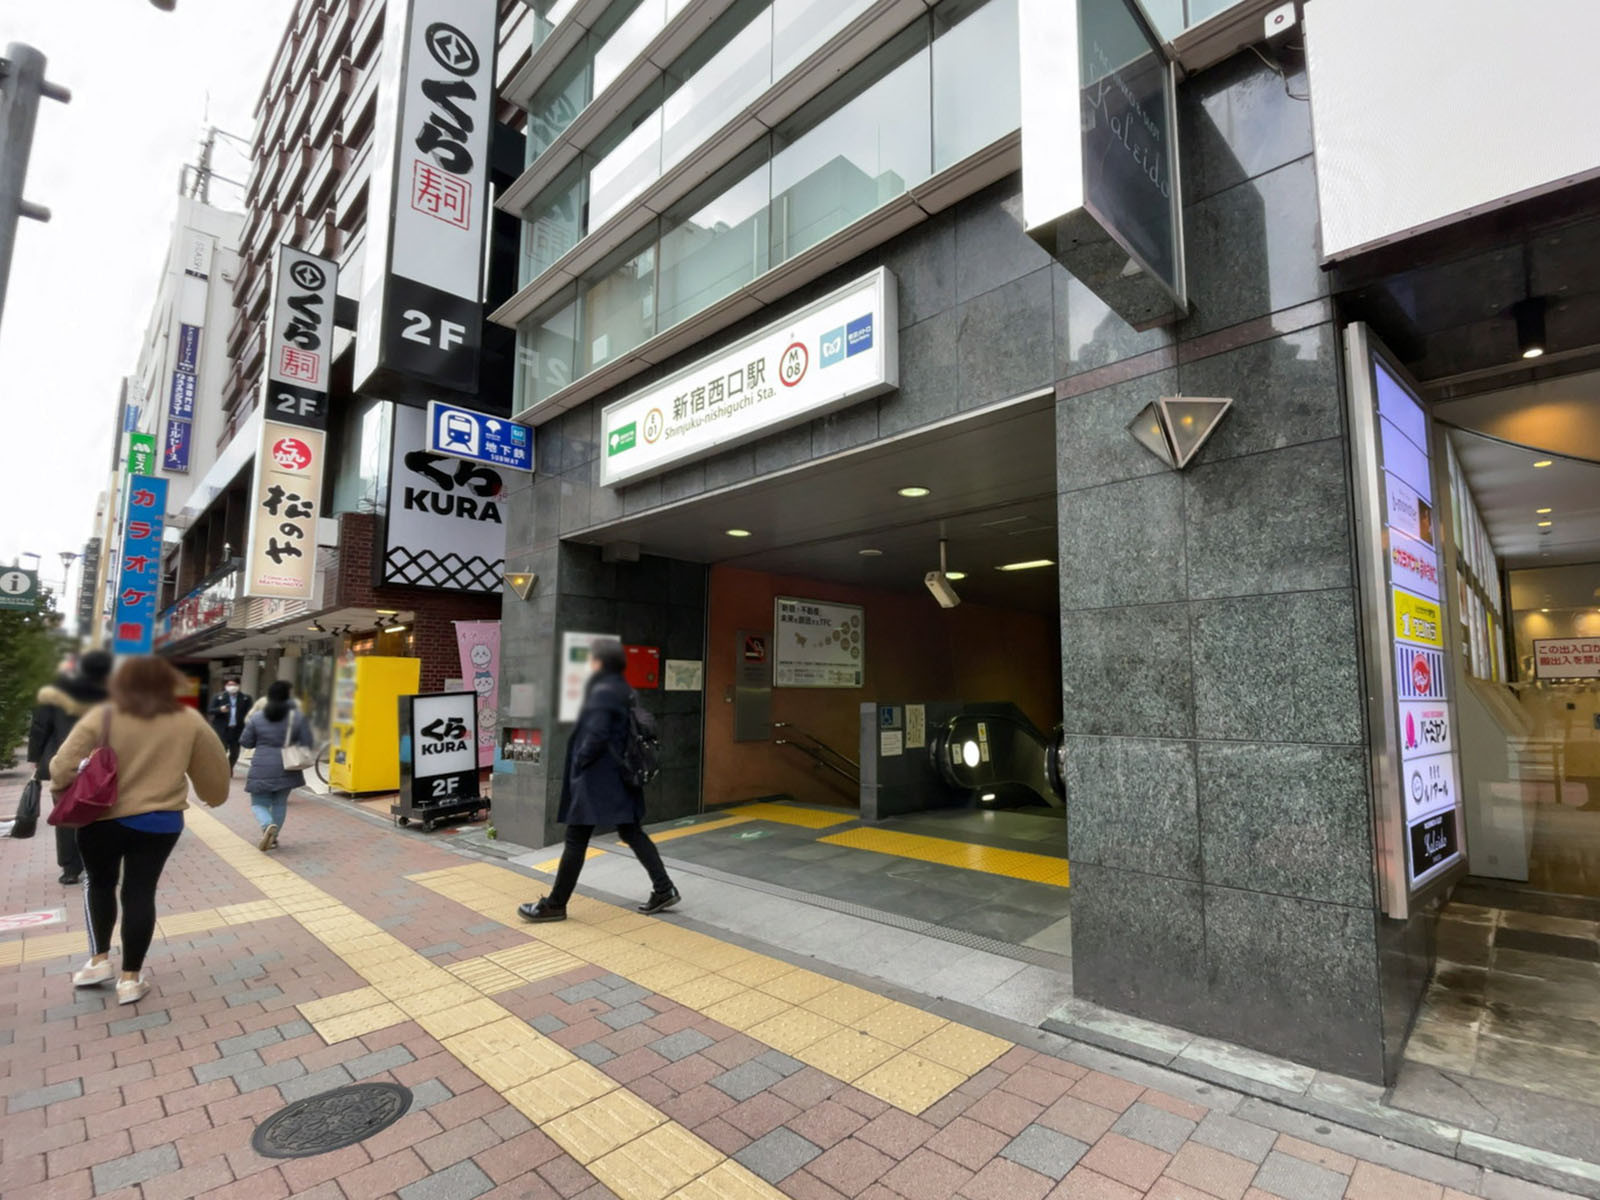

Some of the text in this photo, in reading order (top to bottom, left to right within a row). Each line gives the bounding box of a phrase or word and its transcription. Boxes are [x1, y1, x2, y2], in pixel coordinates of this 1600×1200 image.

[415, 78, 477, 174] くら
[414, 161, 470, 226] 寿司
[284, 294, 323, 351] くら
[402, 310, 465, 351] 2F
[283, 347, 317, 382] 寿司
[789, 349, 798, 362] M
[786, 362, 800, 379] 08
[673, 357, 766, 421] 新宿西口駅
[276, 394, 318, 417] 2F
[665, 394, 754, 440] Shinjuku-nishiguchi
[757, 387, 776, 410] Sta.
[648, 425, 657, 437] 01
[485, 442, 525, 460] 地下鉄
[491, 454, 520, 465] SUBWAY
[404, 487, 502, 524] KURA
[262, 485, 314, 565] 松のや
[421, 717, 467, 741] くら
[422, 741, 468, 757] KURA
[432, 778, 459, 796] 2F
